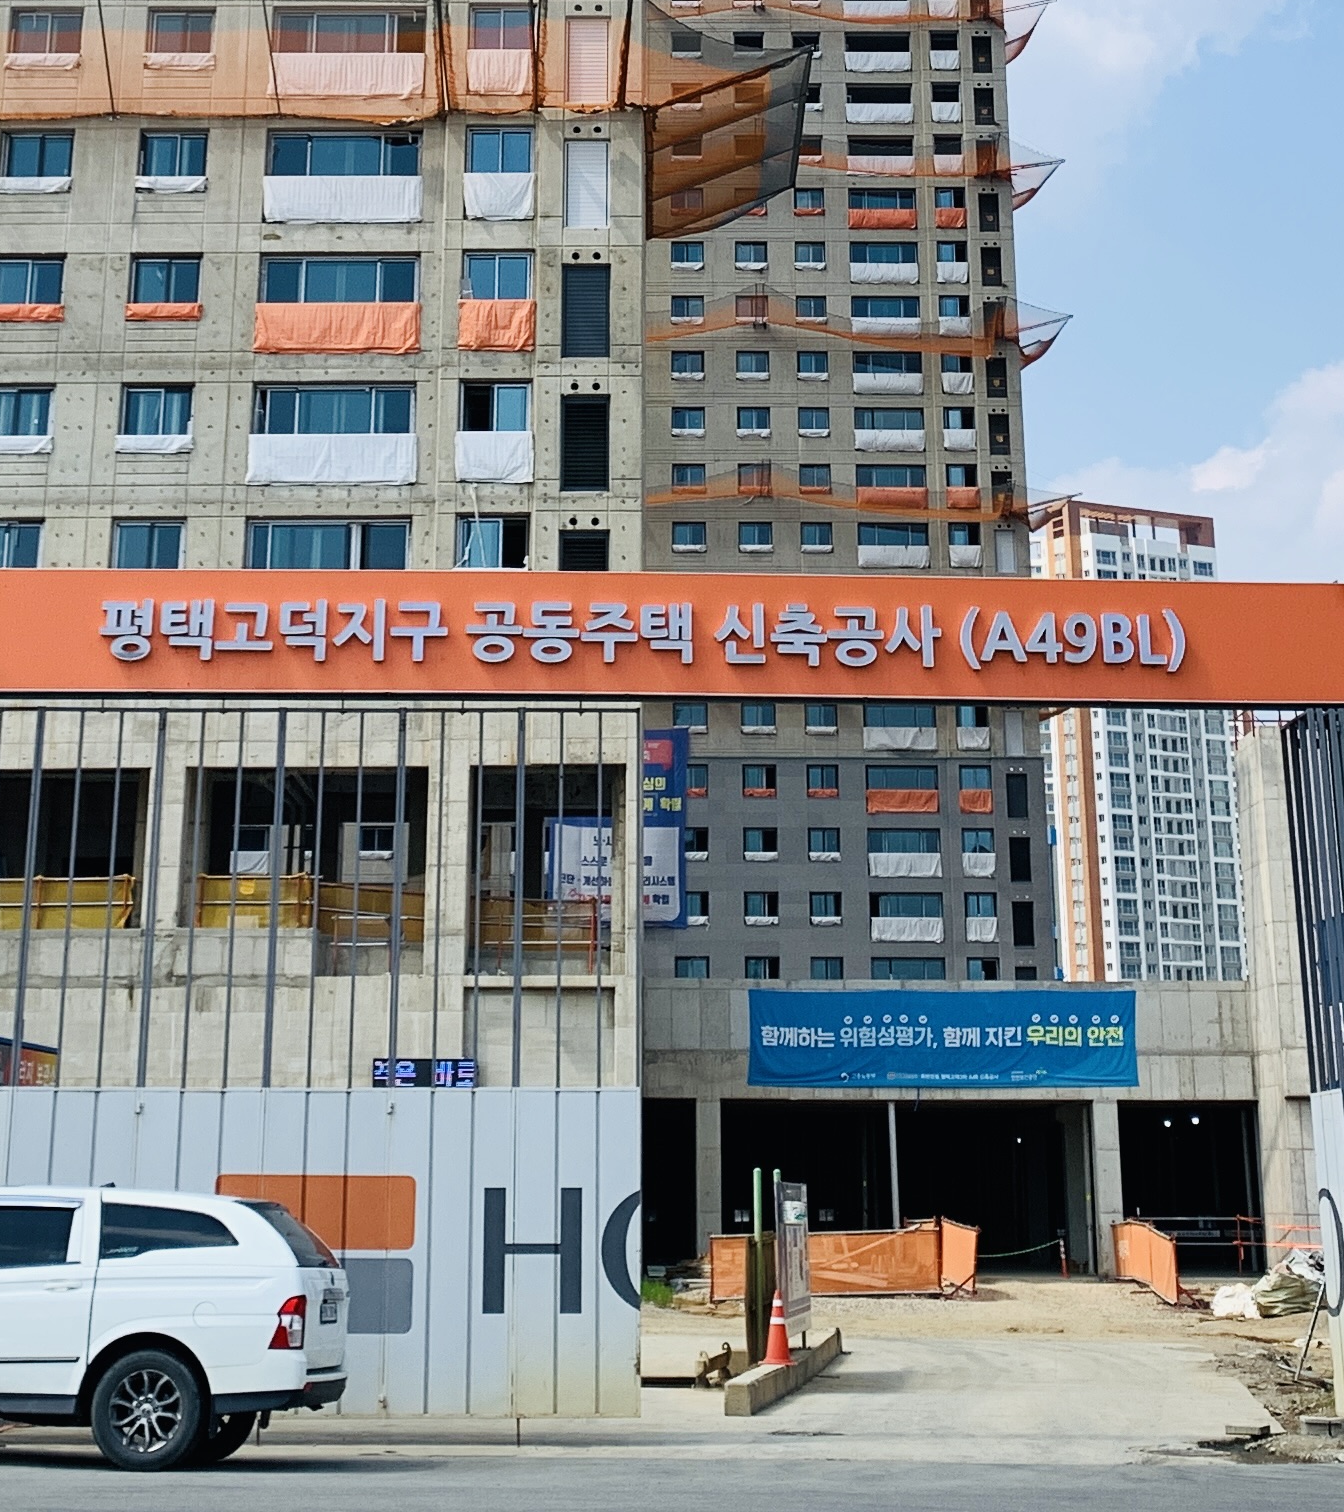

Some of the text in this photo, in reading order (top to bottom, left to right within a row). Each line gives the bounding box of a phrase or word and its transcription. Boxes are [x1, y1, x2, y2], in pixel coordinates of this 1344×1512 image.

[99, 597, 1186, 672] 평택고덕지구 공동주택 신축공사 (A49BL)
[761, 1025, 1124, 1049] 함께하는 위험성평가, 함께 지킨 우리의 안전
